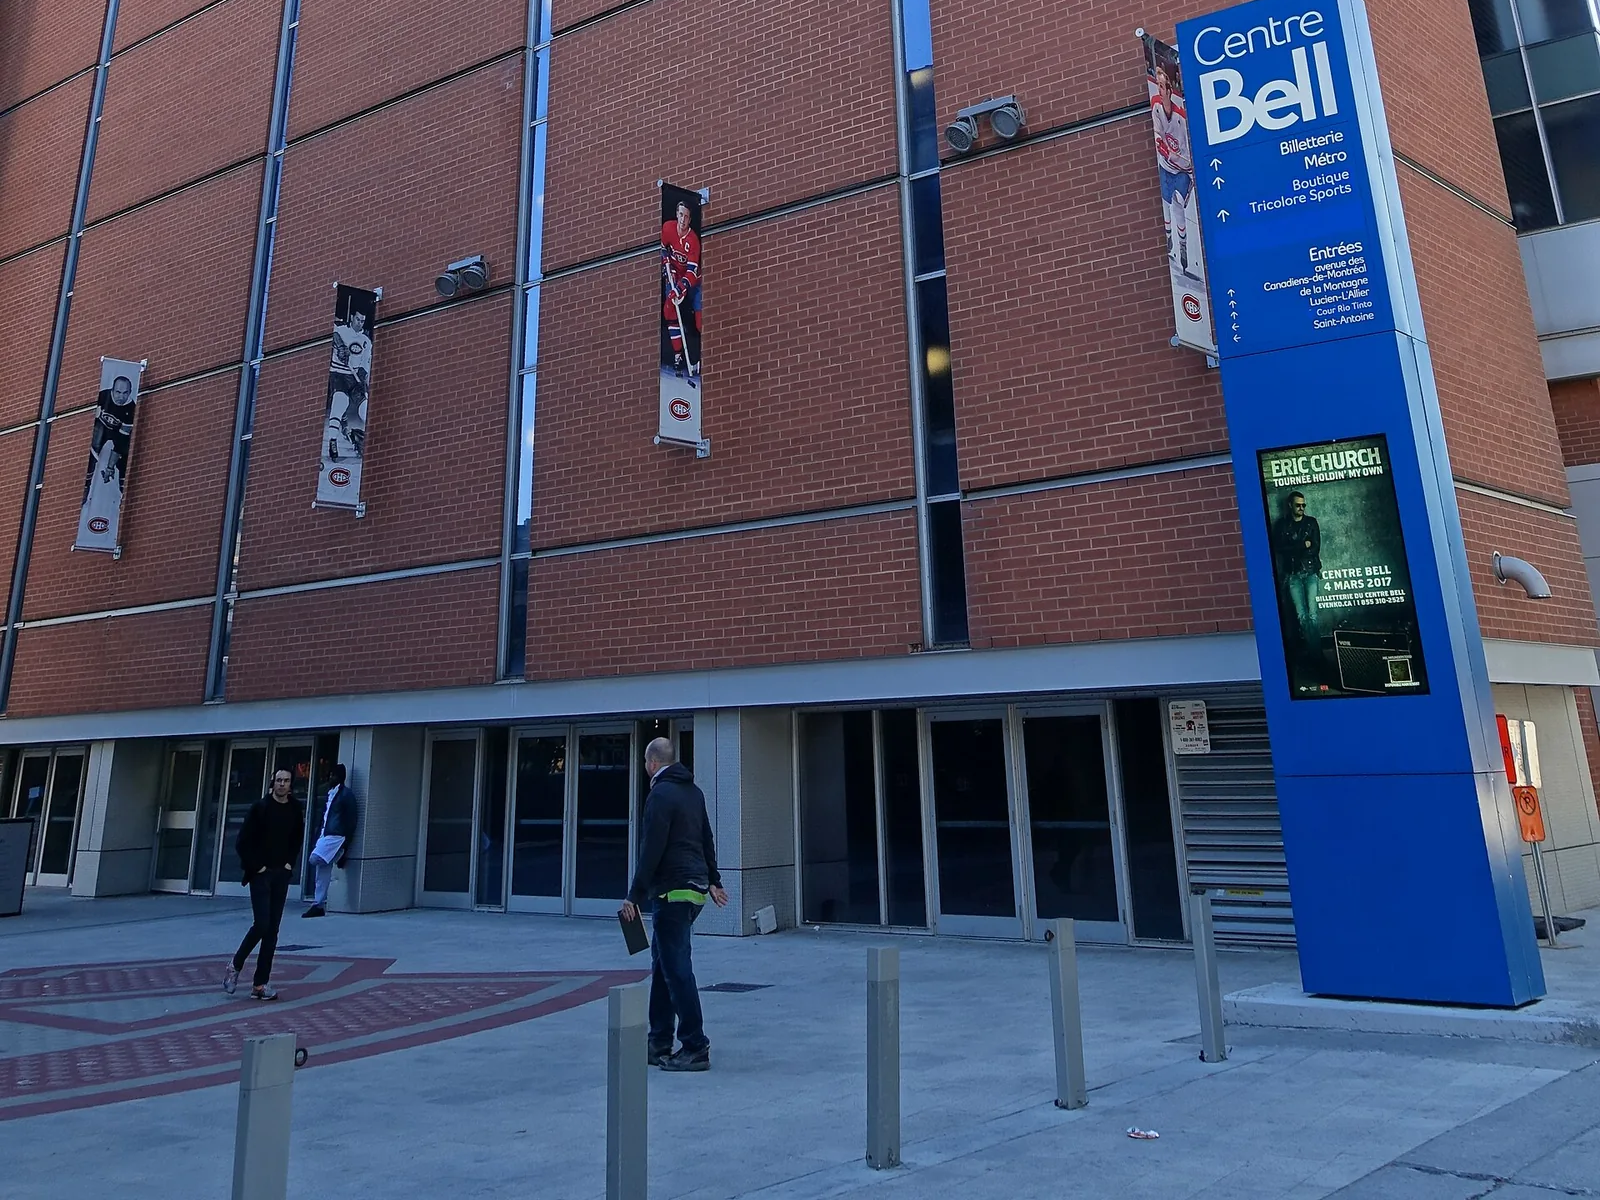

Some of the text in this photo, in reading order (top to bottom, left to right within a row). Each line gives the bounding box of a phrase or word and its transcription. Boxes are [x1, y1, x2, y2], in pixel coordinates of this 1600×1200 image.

[1194, 11, 1324, 66] Centre
[1199, 41, 1338, 146] Bell
[1280, 131, 1344, 155] Billetterie
[1304, 151, 1347, 170] Métro
[1292, 171, 1350, 191] Boutique
[1249, 184, 1352, 213] Tricolore Sports
[1309, 241, 1363, 262] Entrées
[1314, 256, 1365, 273] avenue des
[1263, 264, 1367, 291] Canadiens-de-Montréal
[1300, 277, 1369, 296] de la Montagne
[1309, 288, 1370, 306] Lucien-L'Allier
[1316, 301, 1373, 316] Cour Rio Tinto
[1313, 311, 1375, 329] Saint-Antoine
[1271, 447, 1382, 477] ERIC CHURCH
[1273, 466, 1383, 487] TOURNÉE HOLDIN' MY OWN
[1321, 565, 1391, 580] CENTRE BELL
[1324, 577, 1392, 591] 4 MARS 2017
[1315, 593, 1353, 602] BILLETTERIE
[1364, 590, 1389, 598] CENTRE
[1318, 601, 1353, 609] EVENKO.CA
